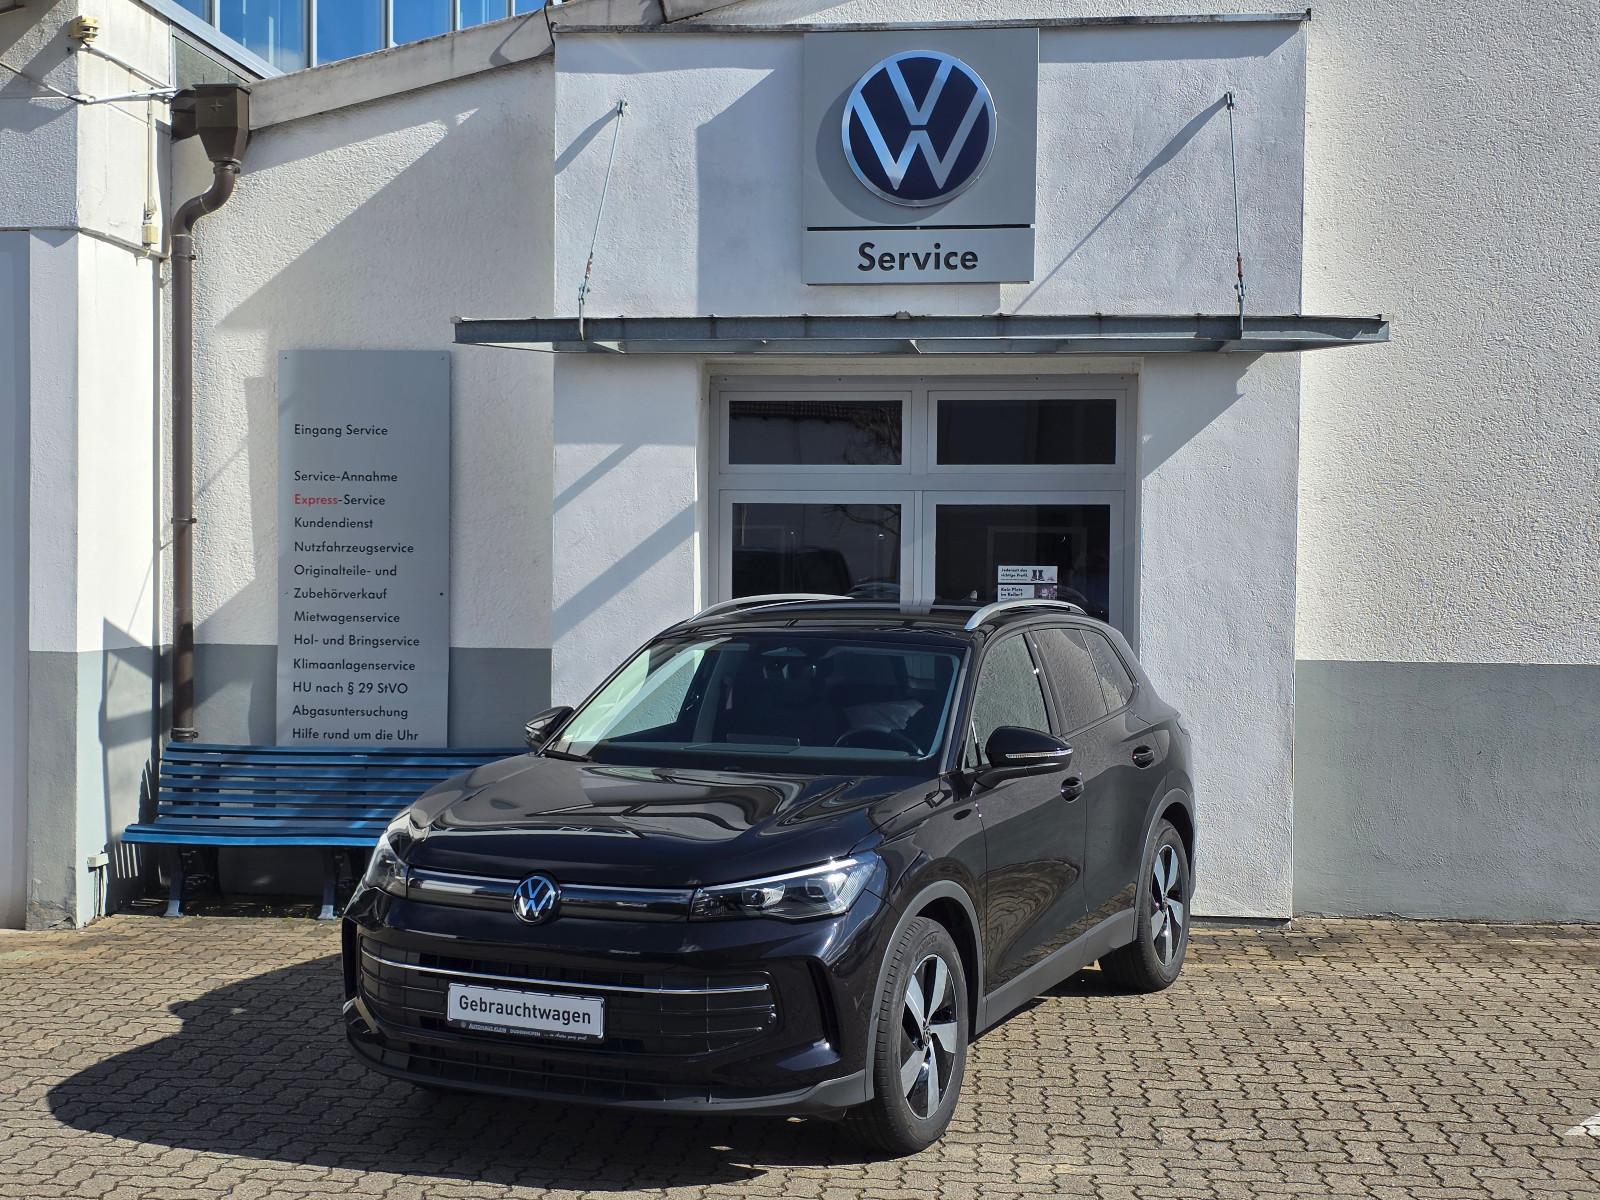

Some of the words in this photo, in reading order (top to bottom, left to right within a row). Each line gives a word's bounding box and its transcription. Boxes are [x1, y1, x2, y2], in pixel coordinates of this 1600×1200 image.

[857, 242, 979, 272] Service
[294, 424, 342, 438] Eingang
[346, 423, 389, 436] Service
[294, 470, 398, 483] Service-Annahme
[294, 493, 386, 507] Express-Service
[294, 516, 374, 529] Kundendienst
[294, 540, 415, 556] Nutzfahrzeugservice
[294, 563, 372, 578] Originalteile-
[375, 564, 397, 577] und
[293, 586, 388, 600] Zubehörverkauf
[293, 610, 401, 625] Mietwagenservice
[293, 633, 319, 646] Hol-
[322, 633, 345, 646] und
[348, 634, 421, 649] Bringservice
[293, 657, 416, 673] Klimaanlagenservice
[292, 680, 312, 693] HU
[315, 681, 344, 694] nach
[347, 681, 355, 696] §
[358, 682, 374, 694] 29
[377, 682, 409, 695] StVO
[292, 704, 409, 721] Abgasuntersuchung
[292, 727, 320, 740] Hilfe
[323, 727, 350, 740] rund
[353, 730, 372, 741] um
[375, 728, 393, 741] die
[396, 729, 420, 741] Uhr
[459, 995, 591, 1026] Gebrauchtwagen
